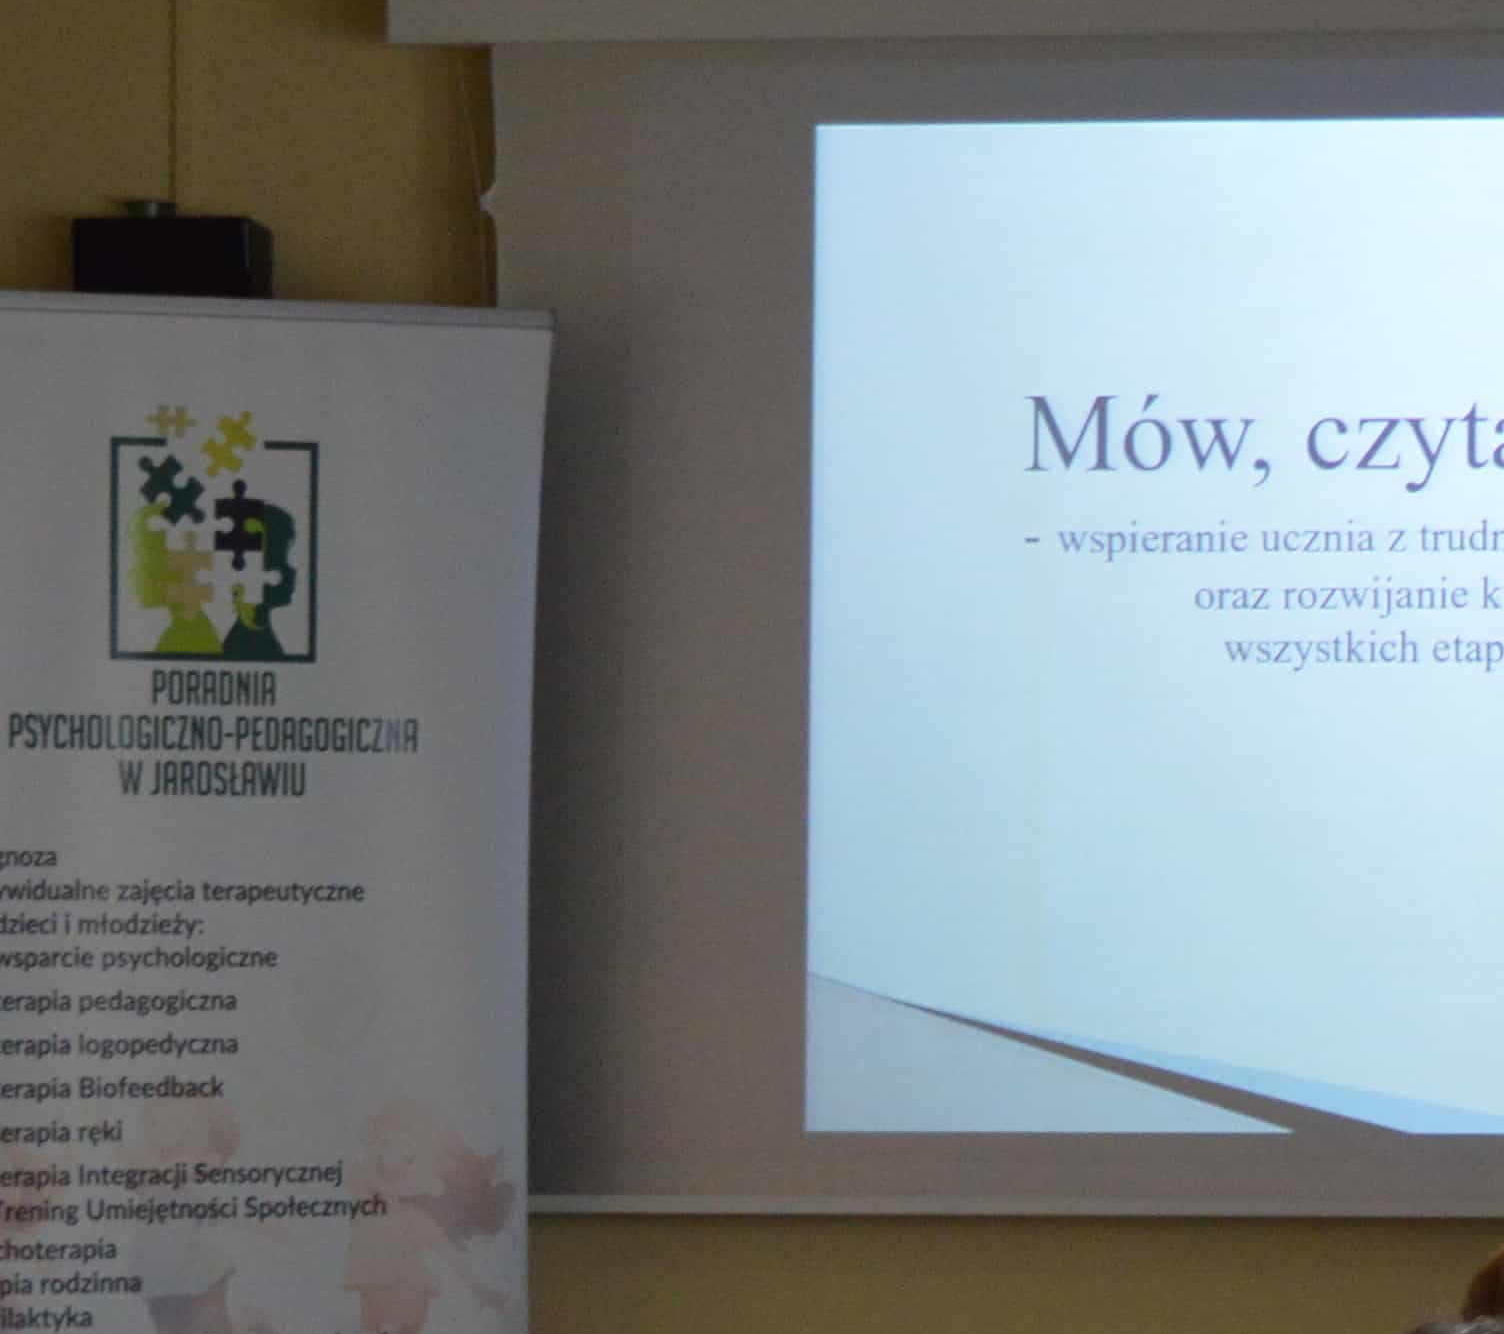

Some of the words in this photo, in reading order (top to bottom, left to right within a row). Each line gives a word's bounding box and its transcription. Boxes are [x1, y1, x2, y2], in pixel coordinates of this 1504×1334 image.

[1025, 394, 1273, 485] Mów,
[1057, 520, 1249, 560] wspieranie
[1259, 520, 1375, 553] ucznia
[1387, 531, 1407, 553] z
[1192, 584, 1270, 610] oraz
[1281, 576, 1470, 619] rozwijanie
[1223, 631, 1421, 672] wszystkich
[151, 670, 277, 706] PORADNIA
[8, 713, 419, 754] PSYCHOLOGICZNO-PEDAGOGICZNA
[119, 762, 143, 796] W
[149, 761, 306, 798] JAROSŁAWIU
[116, 880, 196, 906] zajęcia
[202, 883, 366, 905] terapeutyczne
[64, 914, 72, 937] i
[78, 913, 205, 942] młodzieży:
[101, 945, 279, 973] psychologiczne
[79, 989, 238, 1017] pedagogiczna
[79, 1032, 239, 1060] logopedyczna
[79, 1075, 225, 1101] Biofeedback
[78, 1120, 123, 1146] ręki
[78, 1164, 190, 1191] Integracji
[195, 1160, 344, 1188] Sensorycznej
[86, 1196, 238, 1227] Umiejętności
[244, 1192, 387, 1224] Społecznych
[40, 1271, 142, 1295] rodzinna
